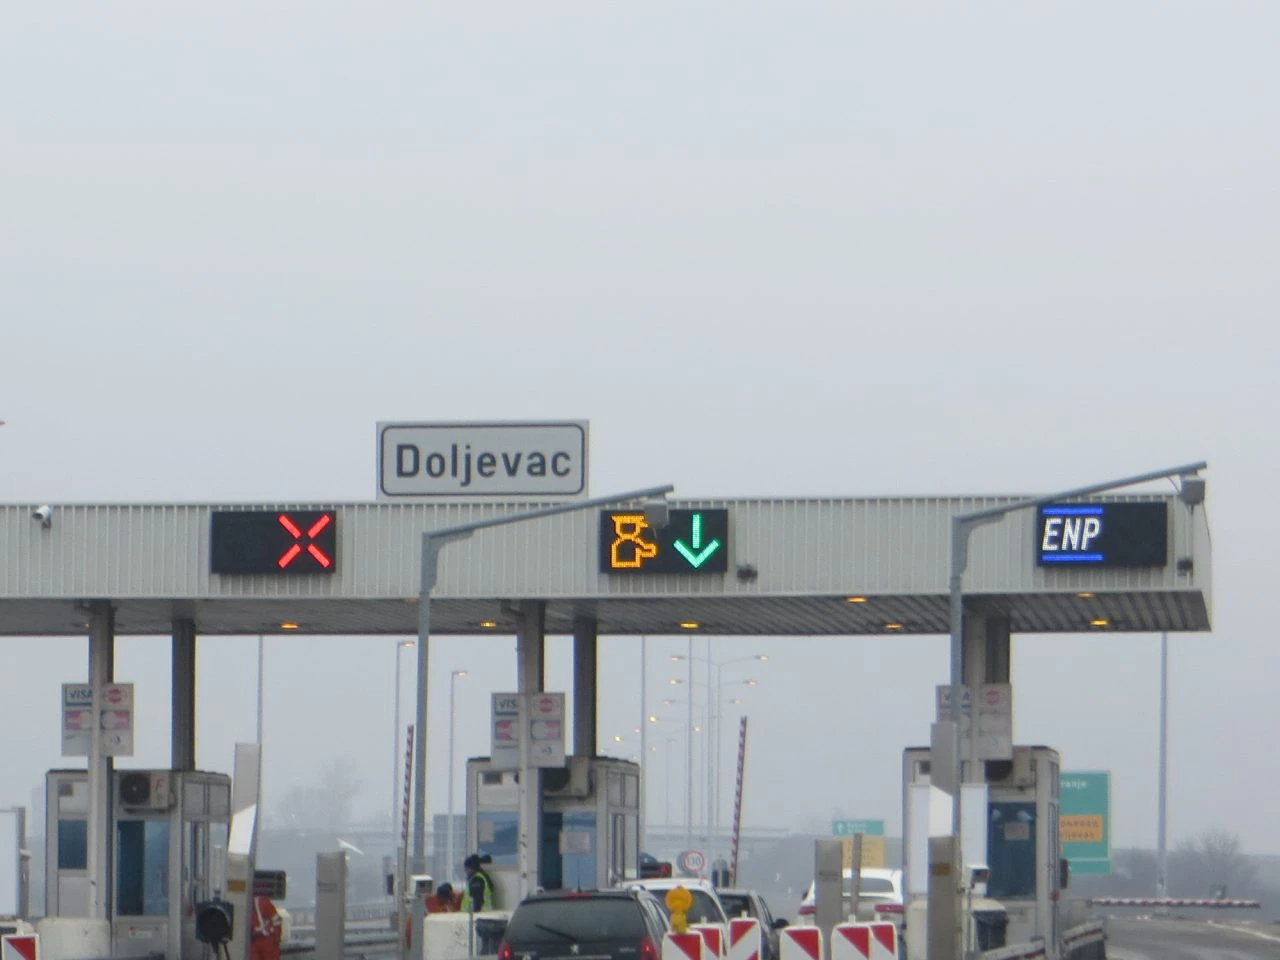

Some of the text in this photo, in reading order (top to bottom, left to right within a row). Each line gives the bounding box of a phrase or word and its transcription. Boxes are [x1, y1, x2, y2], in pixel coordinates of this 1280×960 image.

[396, 443, 571, 487] Doljevac
[1041, 517, 1101, 551] ENP
[1060, 779, 1087, 790] ranje
